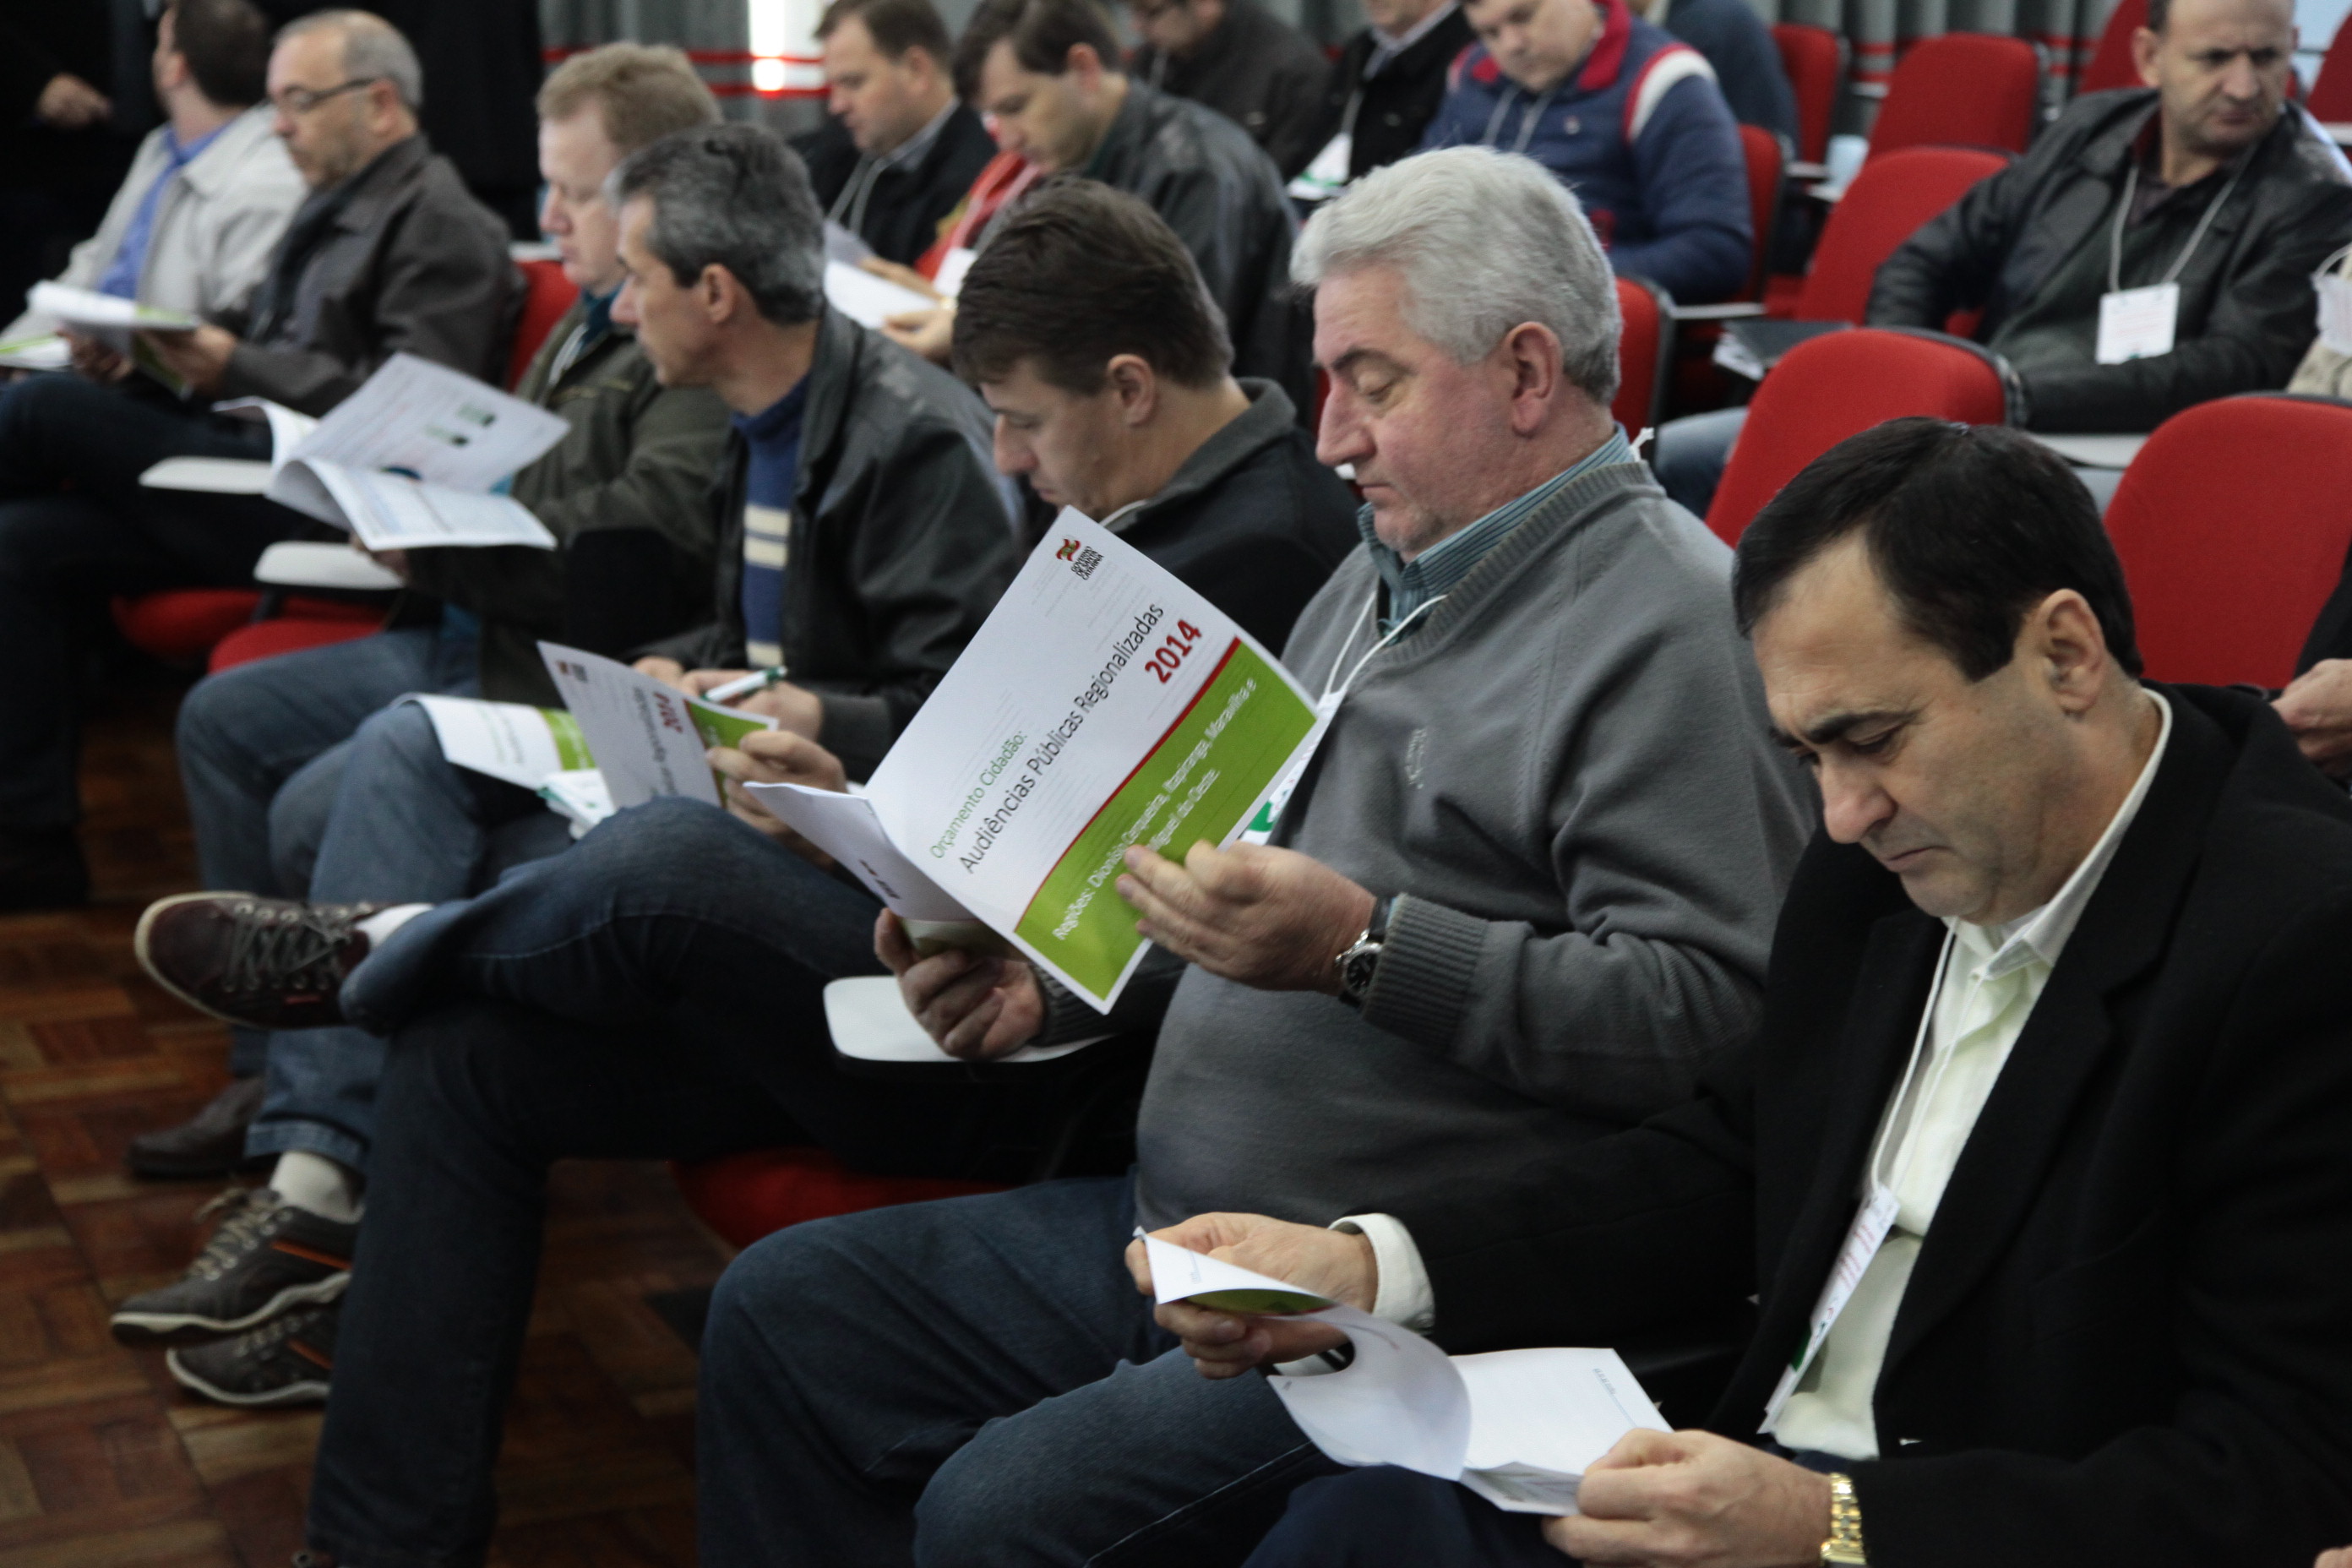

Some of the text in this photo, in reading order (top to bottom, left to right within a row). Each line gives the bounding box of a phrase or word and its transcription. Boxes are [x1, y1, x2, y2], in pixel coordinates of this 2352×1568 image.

[1070, 546, 1092, 572] GOVERNO
[1081, 550, 1098, 568] SANTA
[1082, 553, 1104, 580] CATARINA
[1144, 618, 1202, 684] 2014
[959, 603, 1164, 874] Audiências Públicas Regionalizadas
[930, 730, 1027, 858] Orçamento Cidadão:
[1052, 887, 1096, 940] Regiões:
